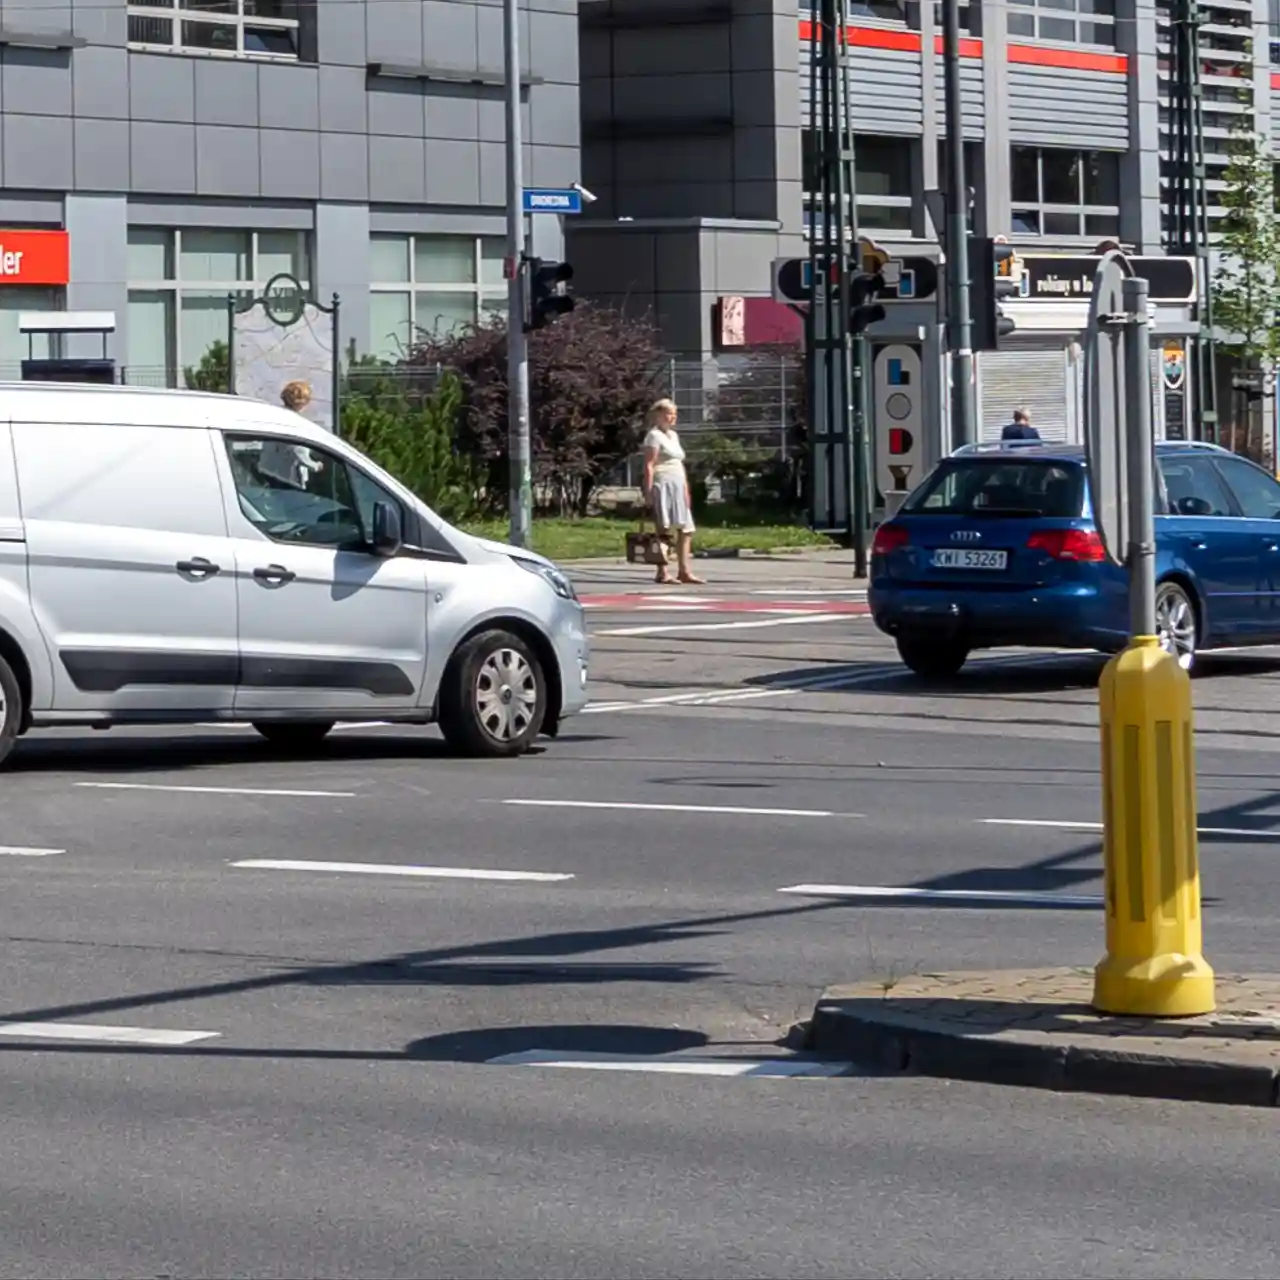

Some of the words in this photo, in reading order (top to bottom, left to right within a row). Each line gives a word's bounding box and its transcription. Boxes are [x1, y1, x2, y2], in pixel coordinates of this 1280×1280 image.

[1082, 274, 1094, 293] lo
[886, 358, 913, 490] LODY
[964, 551, 1005, 567] 53261
